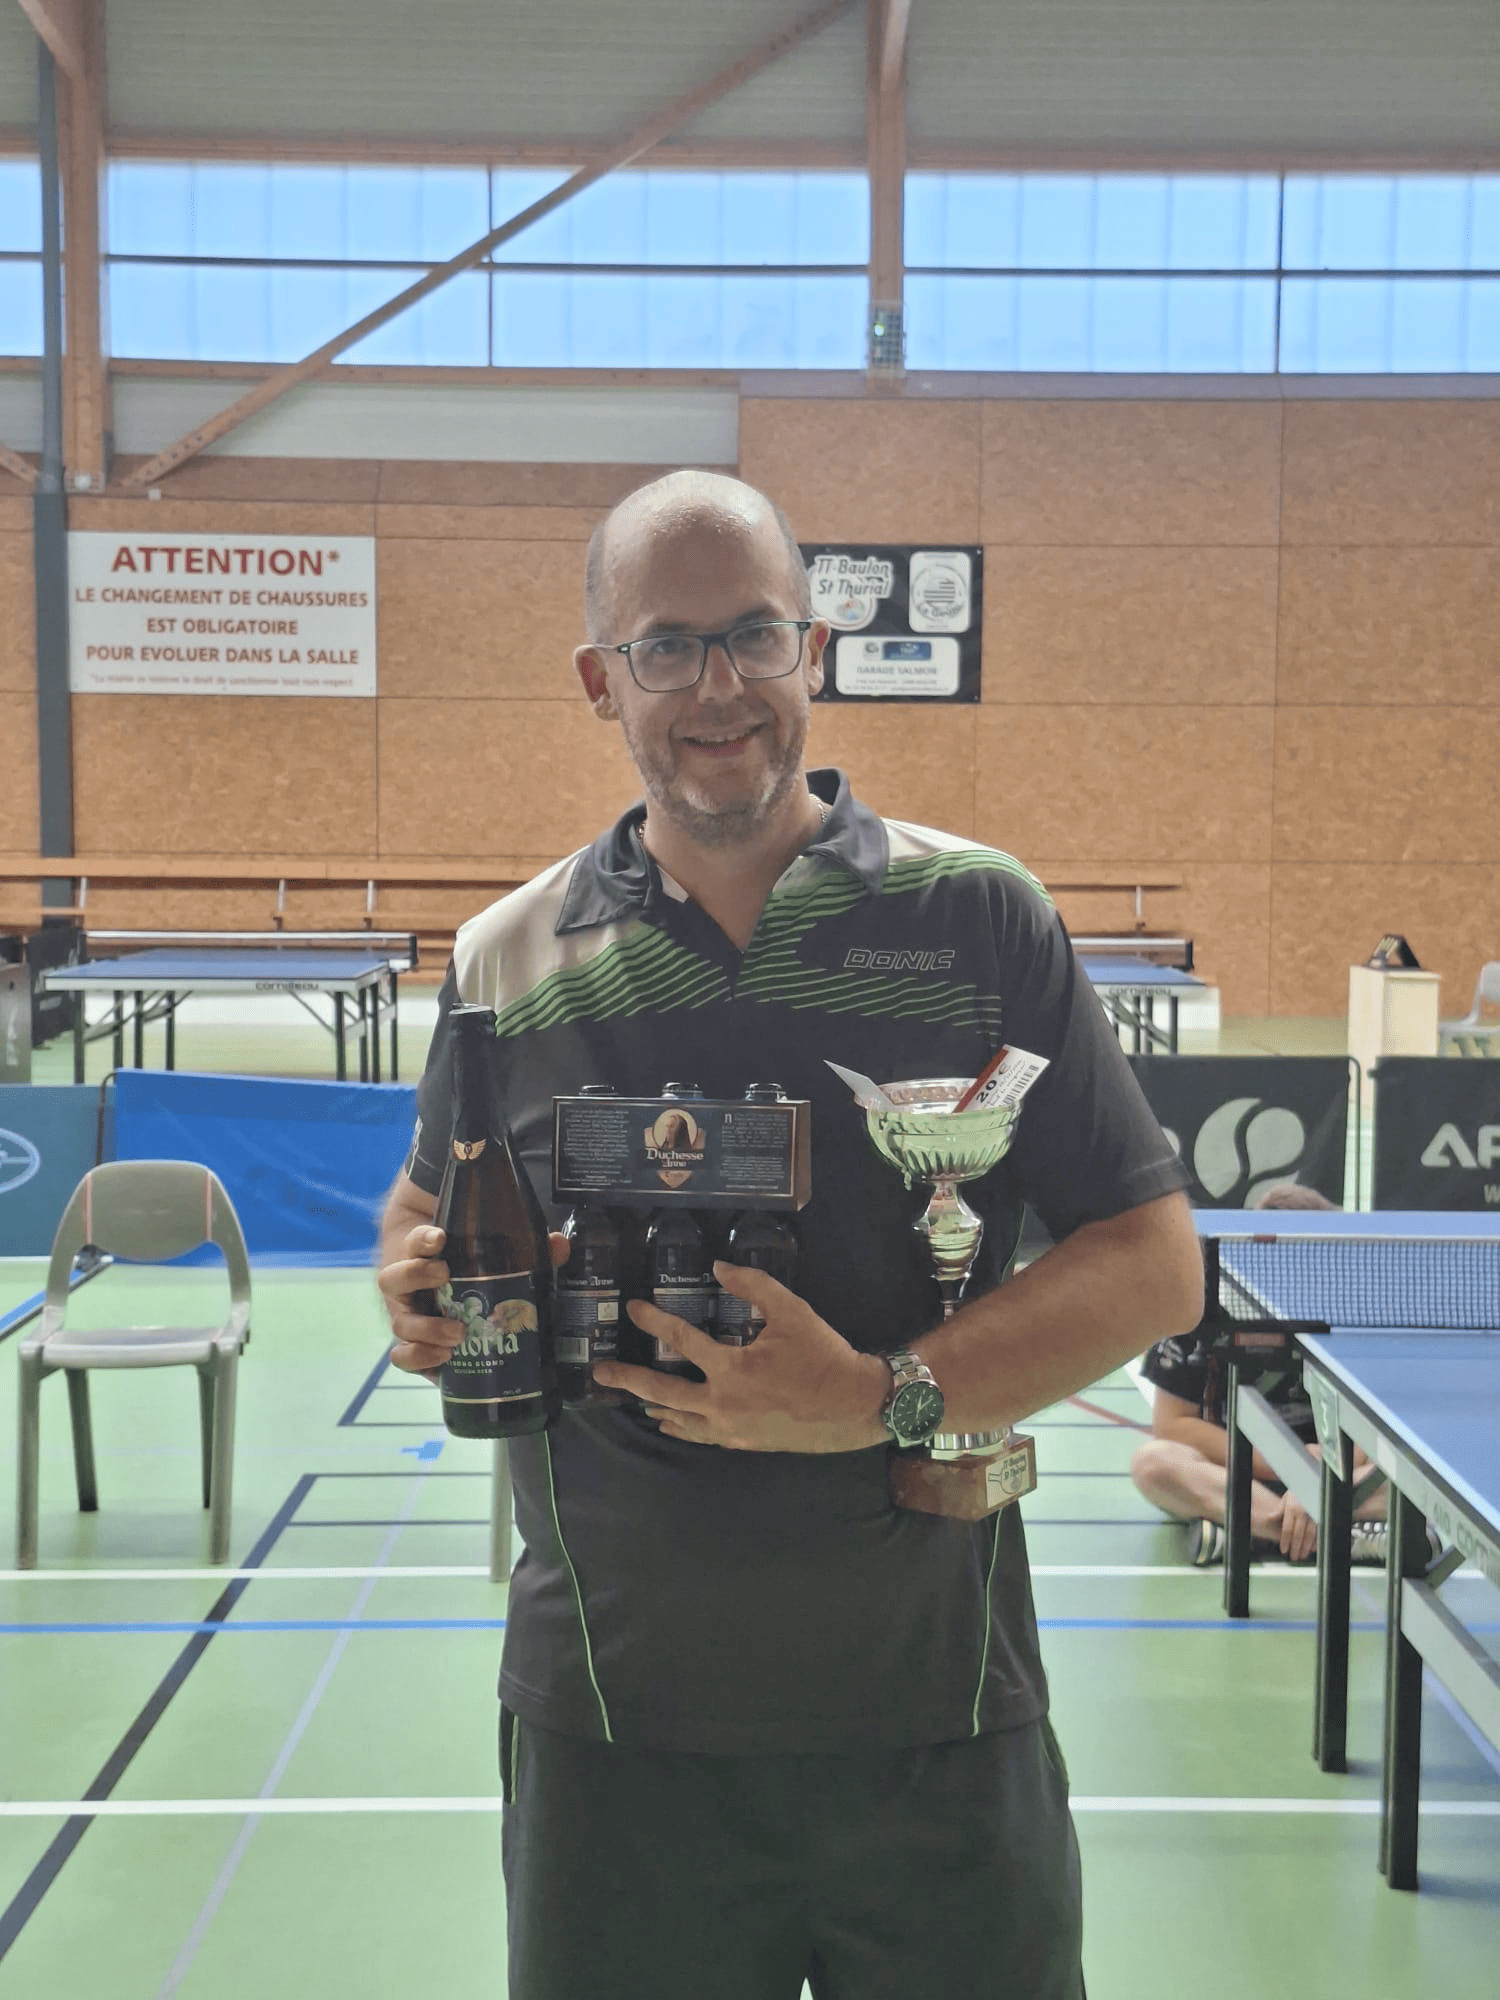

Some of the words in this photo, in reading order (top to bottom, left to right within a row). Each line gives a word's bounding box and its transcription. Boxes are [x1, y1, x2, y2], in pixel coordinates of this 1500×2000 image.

[817, 558, 833, 575] TT
[837, 558, 889, 578] Baulon
[75, 588, 94, 602] LE
[101, 588, 222, 606] CHANGEMENT
[229, 590, 251, 606] DE
[257, 591, 368, 607] CHAUSSURES
[817, 579, 834, 595] St
[838, 579, 889, 598] Thurial
[147, 617, 177, 633] EST
[183, 618, 298, 636] OBLIGATOIRE
[86, 645, 134, 661] POUR
[141, 646, 219, 663] EVOLUER
[225, 648, 272, 663] DANS
[279, 648, 301, 664] LA
[307, 649, 359, 665] SALLE
[843, 948, 956, 971] DONIC
[976, 1079, 997, 1103] 20
[645, 1147, 704, 1161] Duchesse
